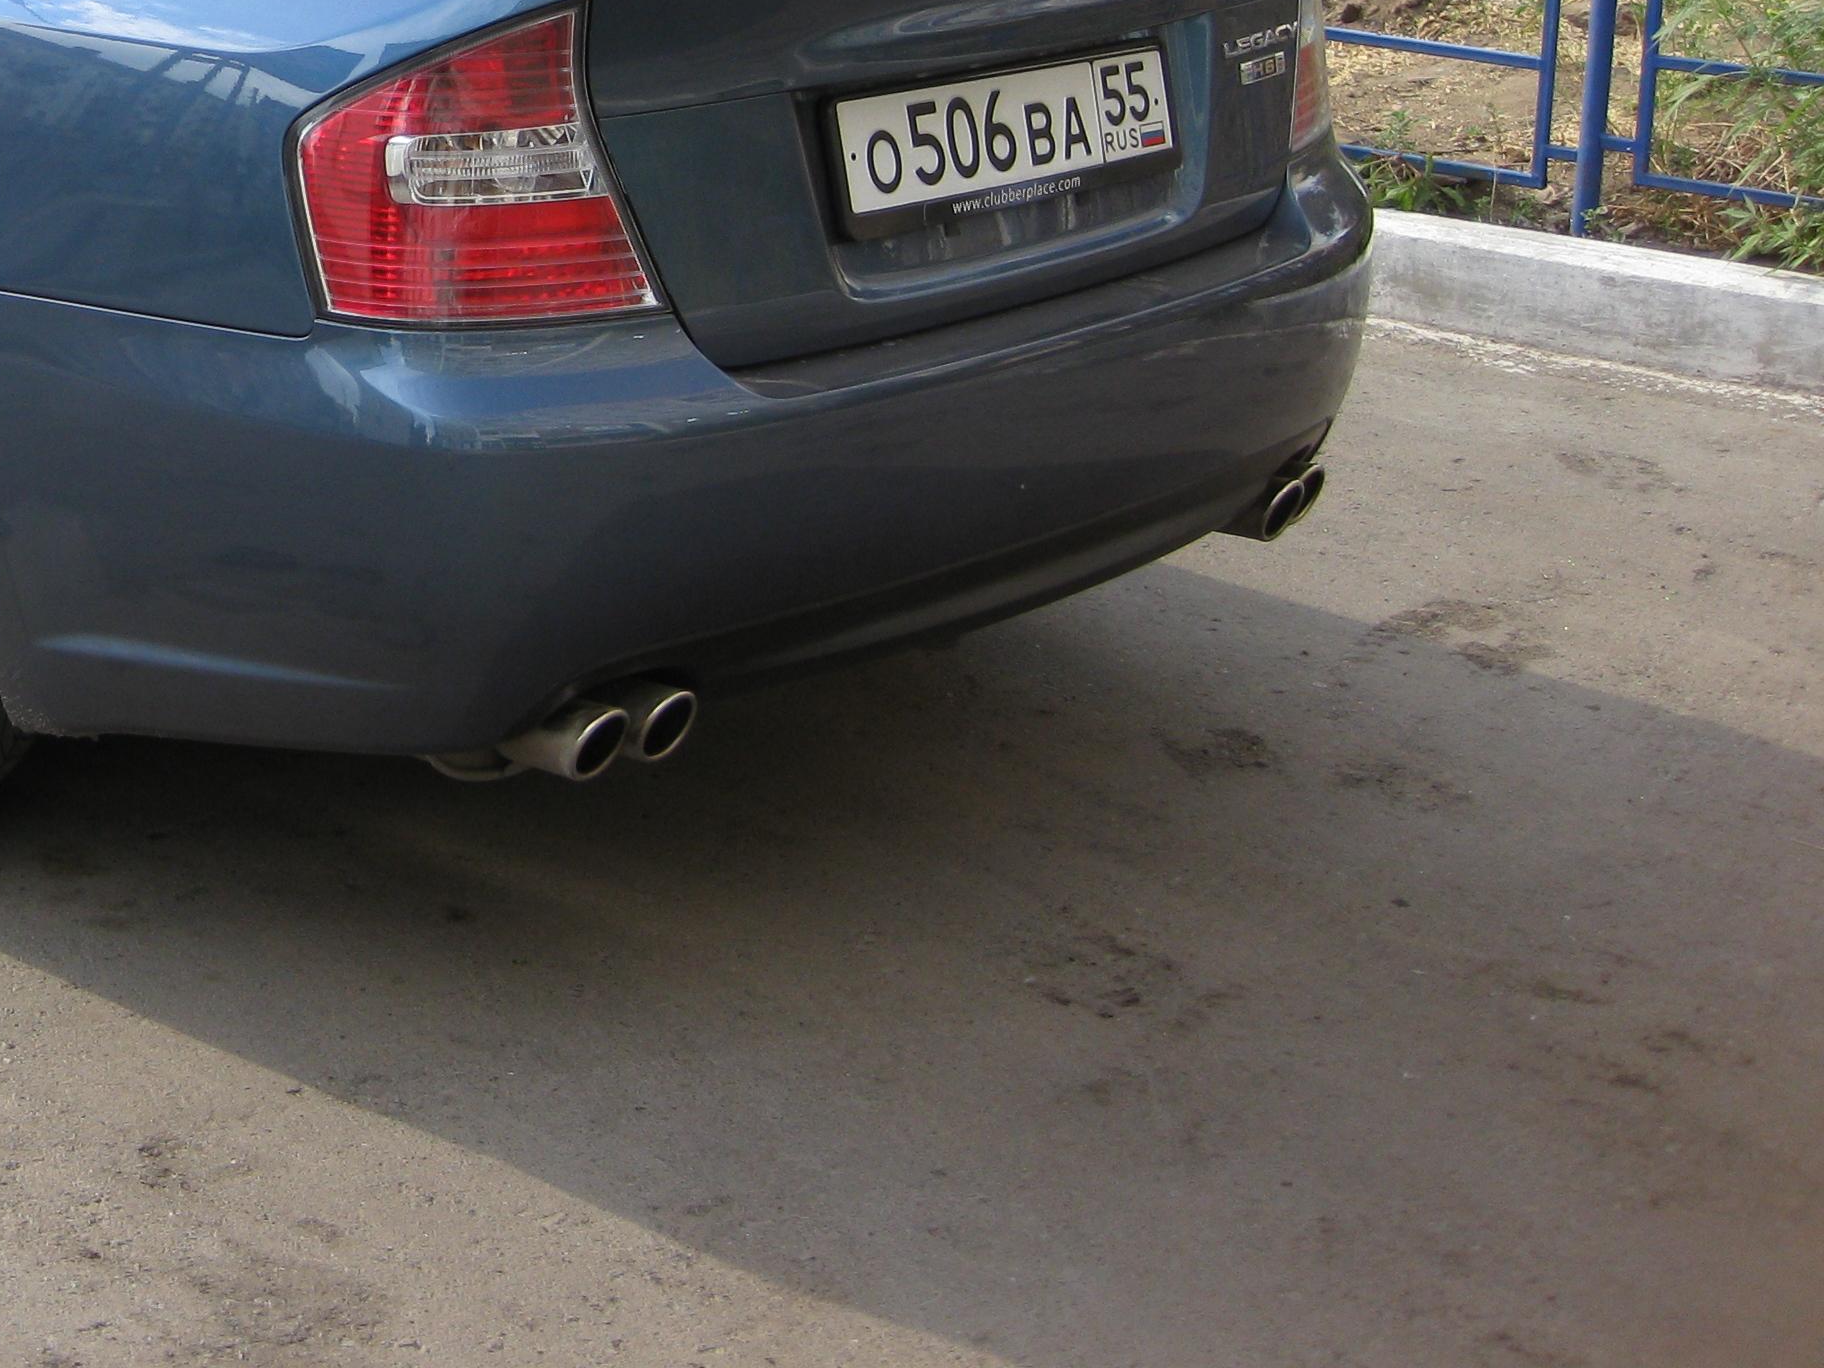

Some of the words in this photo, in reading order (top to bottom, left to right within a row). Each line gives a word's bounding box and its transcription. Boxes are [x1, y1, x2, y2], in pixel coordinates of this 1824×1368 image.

[1099, 61, 1150, 126] 55
[1104, 131, 1140, 153] RUS
[952, 175, 1081, 214] www.clubberplace.com
